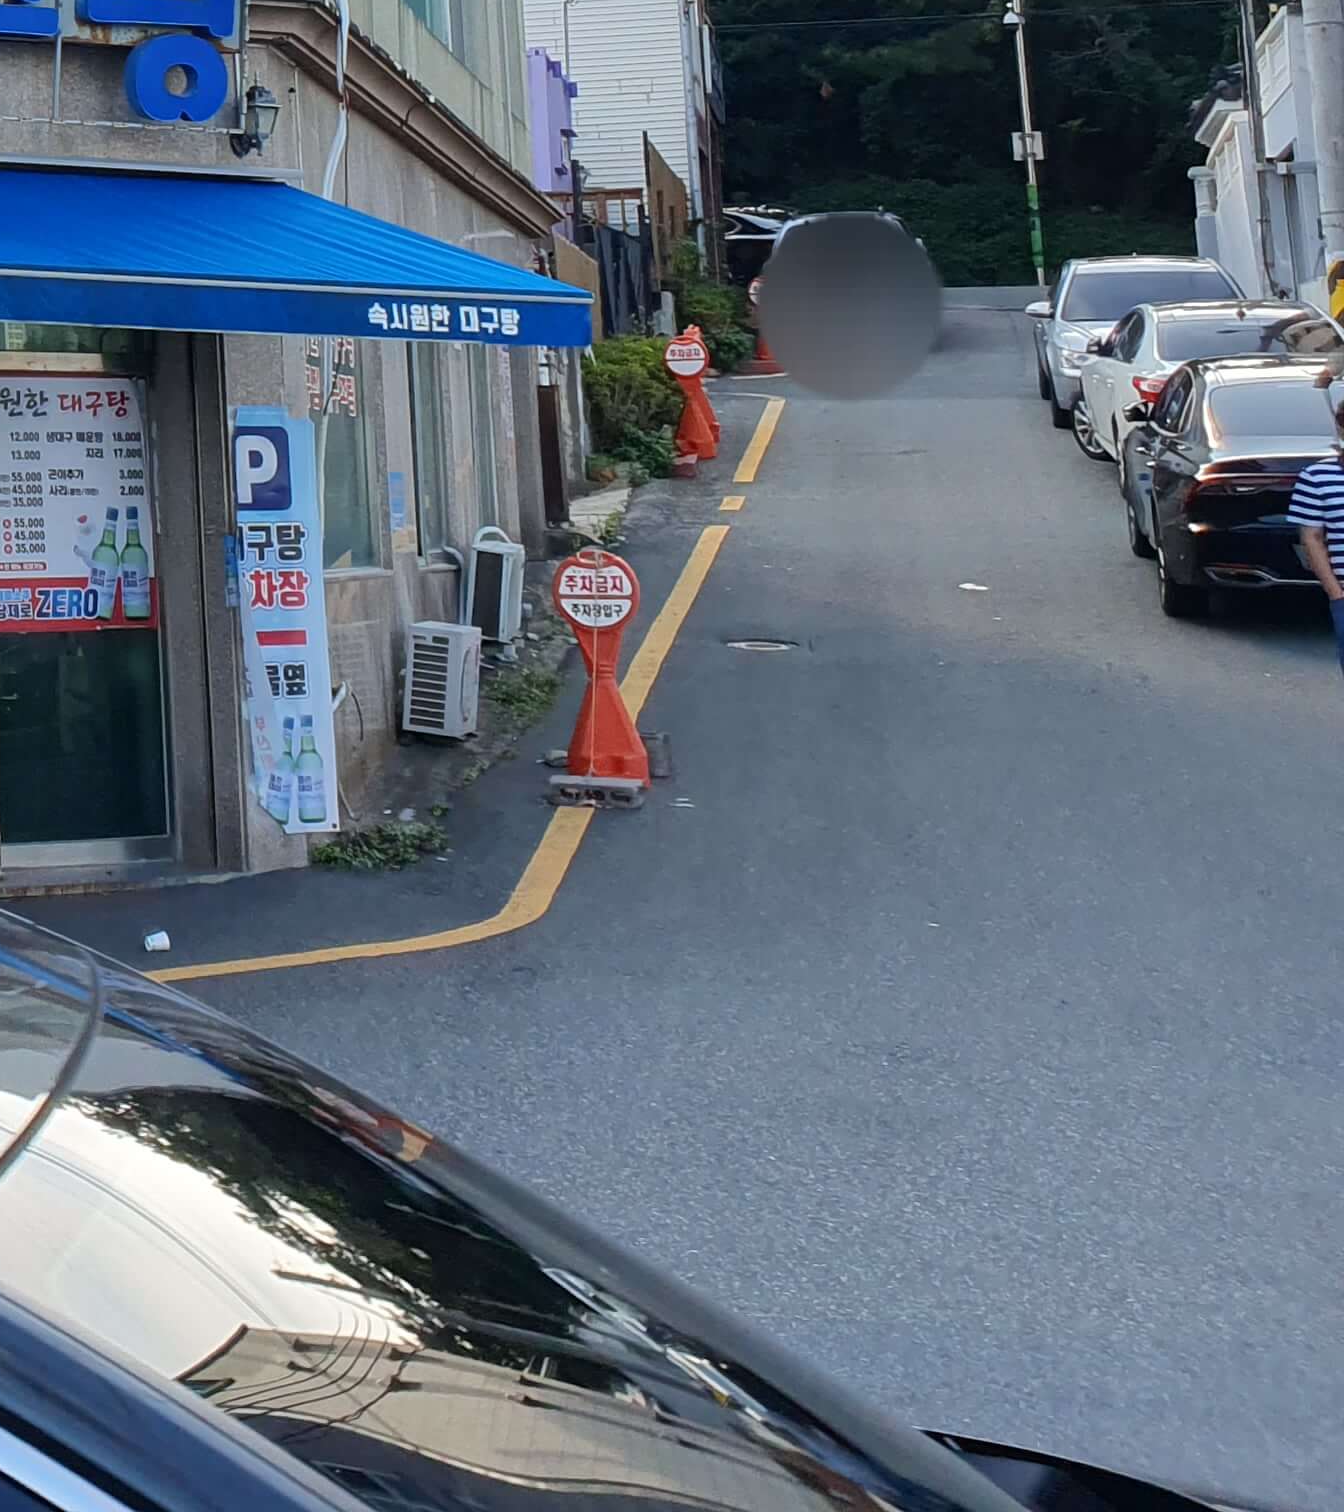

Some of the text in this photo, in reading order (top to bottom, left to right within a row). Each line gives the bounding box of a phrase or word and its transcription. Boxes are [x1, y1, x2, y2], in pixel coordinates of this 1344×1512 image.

[368, 302, 451, 333] 속시원한
[57, 390, 131, 419] 대구탕
[235, 435, 278, 505] P
[238, 525, 307, 562] 구탕
[36, 589, 100, 619] ZERO
[244, 569, 309, 609] 차장
